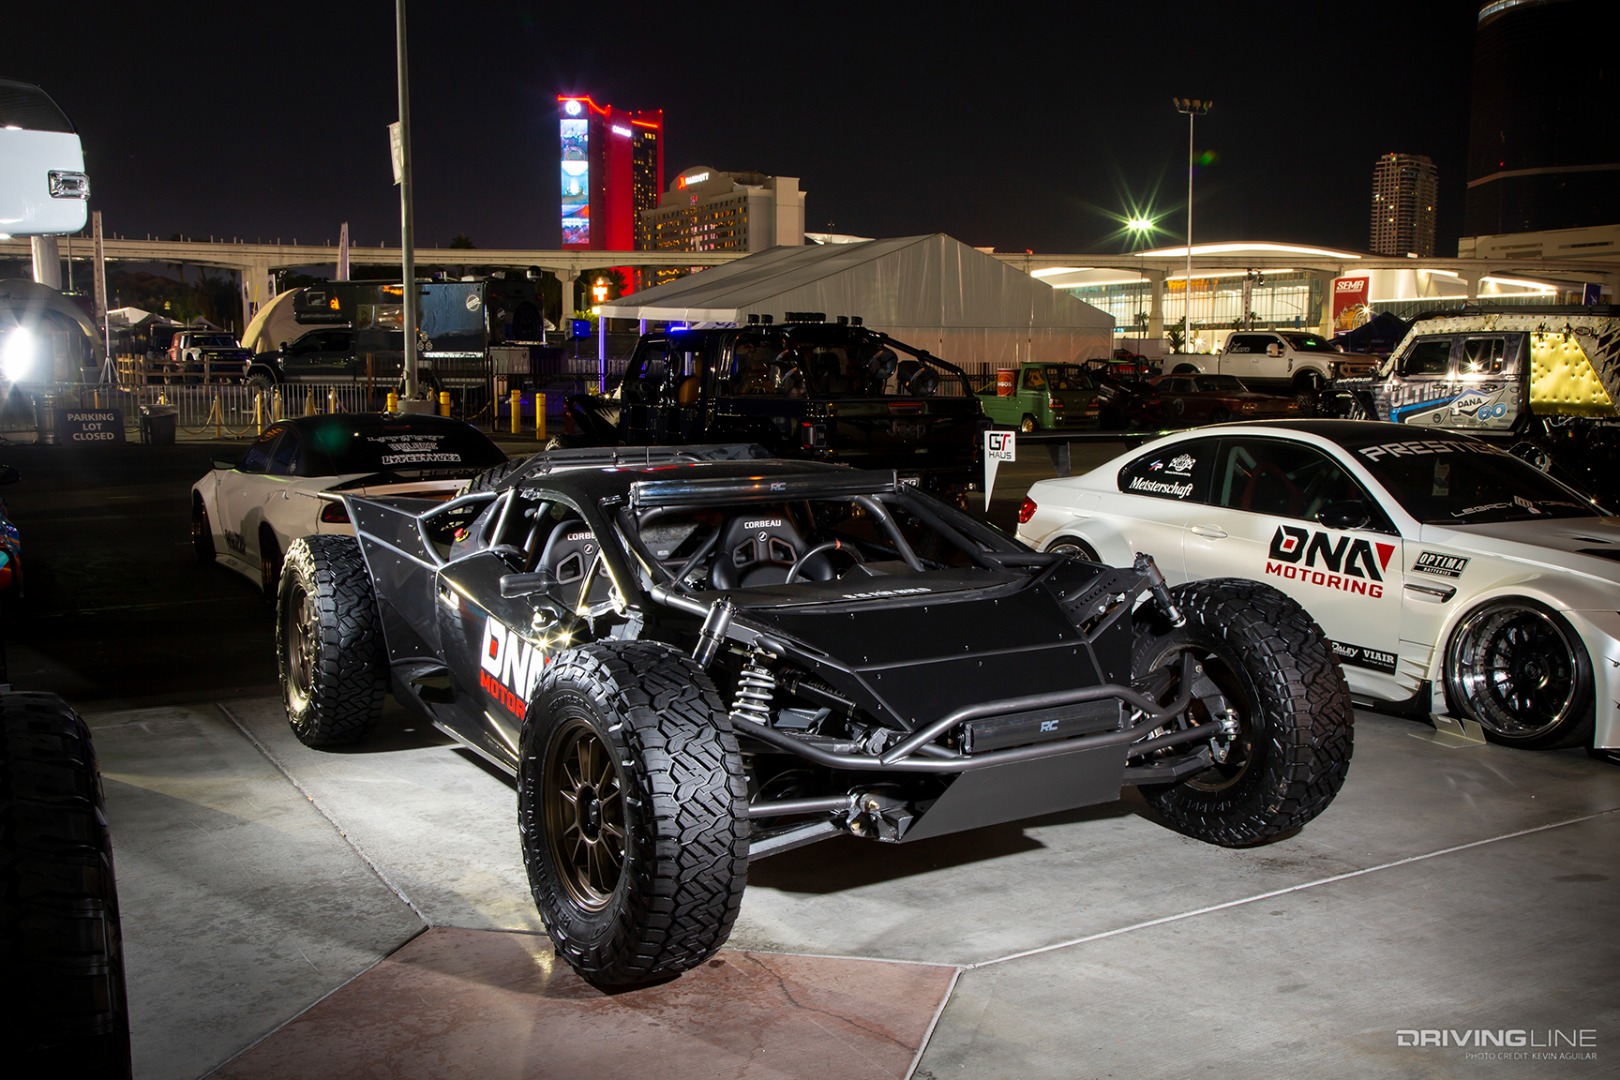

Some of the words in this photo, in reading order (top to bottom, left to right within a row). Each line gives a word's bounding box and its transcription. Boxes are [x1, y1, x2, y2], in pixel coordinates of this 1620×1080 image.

[1337, 280, 1364, 290] SEMA
[1457, 397, 1483, 408] DANA
[67, 413, 115, 421] PARKING
[1478, 403, 1507, 421] 60
[82, 423, 102, 431] LOT
[887, 420, 927, 439] Jeep
[72, 432, 115, 441] CLOSED
[989, 433, 1011, 450] GT
[989, 451, 1012, 460] HAUS
[1358, 440, 1509, 462] PRESTIG
[770, 482, 787, 491] RC
[1128, 476, 1194, 499] Meisterschaft
[1450, 502, 1513, 518] LEGACY
[744, 519, 782, 529] CORBEAU
[1268, 525, 1395, 582] DNA
[1418, 553, 1466, 571] OPTIMA
[1423, 567, 1451, 576] BATTERIES
[1266, 562, 1383, 599] MOTORING
[1363, 649, 1395, 664] VIAIR
[480, 669, 526, 721] MOTOR
[1040, 720, 1059, 732] RC
